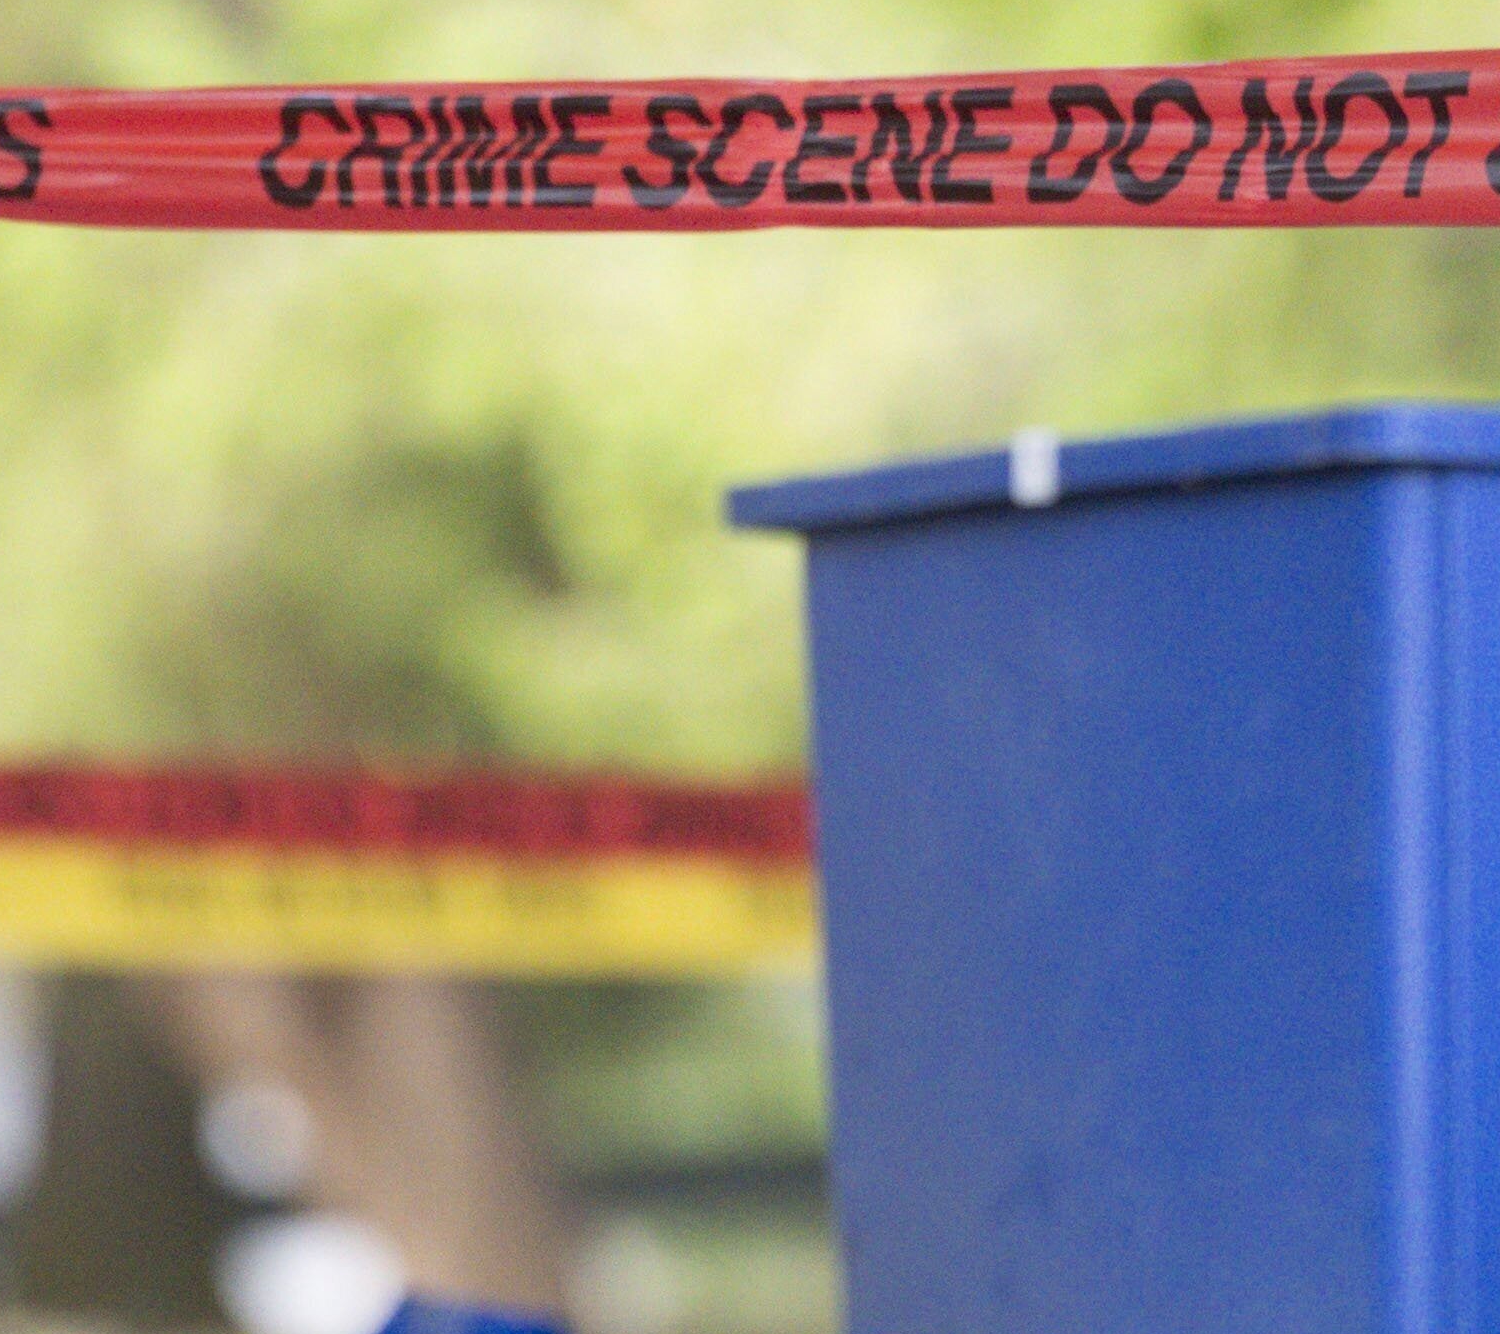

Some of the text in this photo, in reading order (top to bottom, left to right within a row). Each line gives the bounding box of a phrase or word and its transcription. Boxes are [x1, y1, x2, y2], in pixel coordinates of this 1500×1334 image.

[259, 88, 612, 211] CRIME
[622, 85, 1015, 209] SCENE
[1027, 77, 1213, 205] DO
[1217, 69, 1471, 203] NOT
